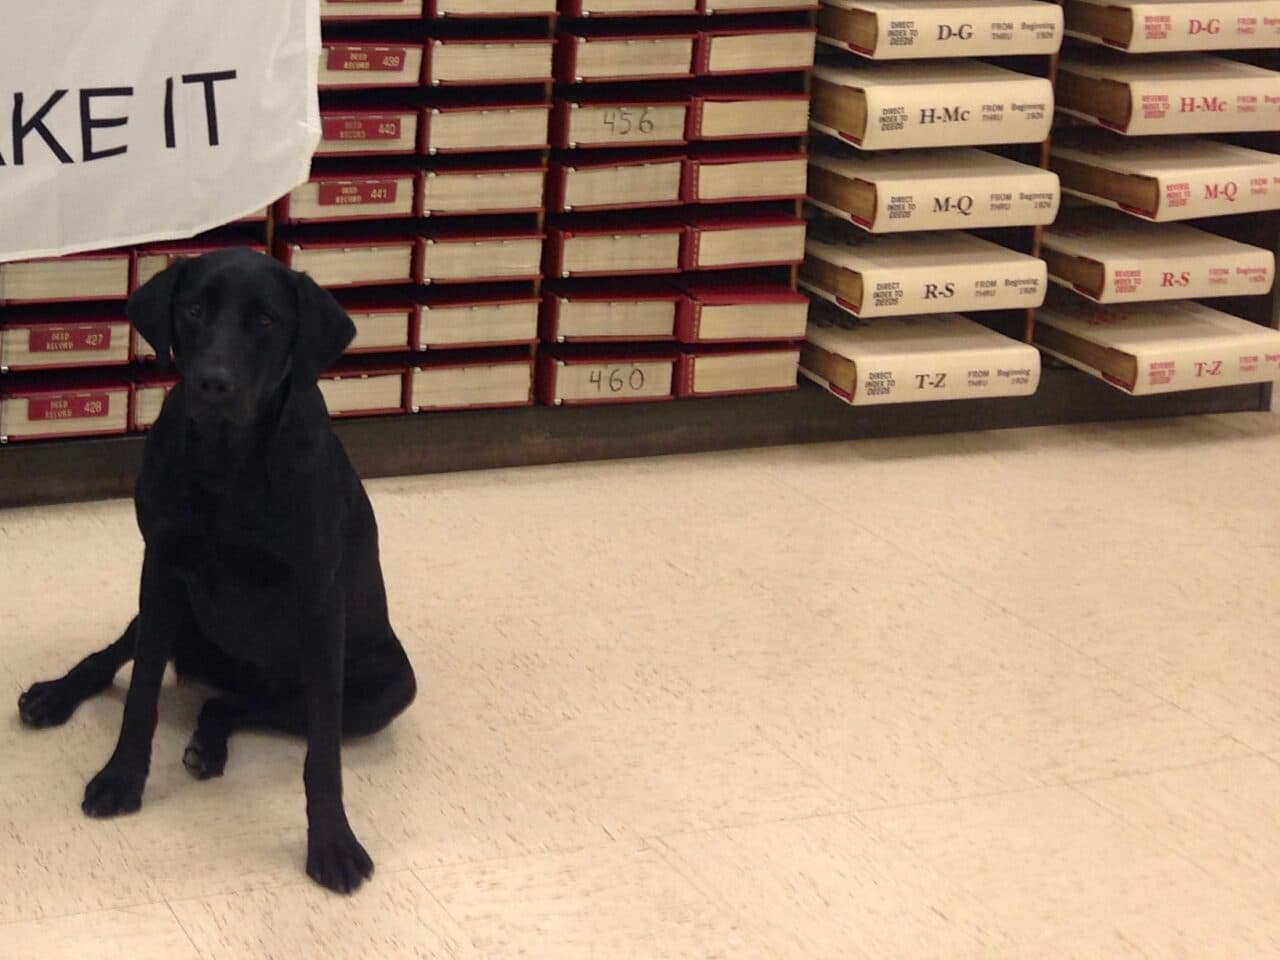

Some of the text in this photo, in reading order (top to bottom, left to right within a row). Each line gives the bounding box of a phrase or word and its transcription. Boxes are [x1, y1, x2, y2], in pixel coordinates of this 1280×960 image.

[937, 24, 974, 40] D-G
[1021, 22, 1056, 31] Beginning
[1188, 19, 1221, 35] D-G
[164, 70, 236, 148] IT
[982, 103, 1045, 112] FROM Beginning
[1179, 96, 1227, 113] H-Mc
[603, 107, 654, 136] 456
[920, 106, 970, 124] H-Mc
[378, 123, 396, 135] 440
[371, 188, 388, 199] 441
[990, 192, 1054, 201] FROM Beginning
[1204, 181, 1238, 202] M-Q
[933, 195, 973, 216] M-Q
[975, 279, 1039, 288] FROM Beginning
[1160, 271, 1191, 288] R-S
[924, 282, 955, 300] R-S
[46, 341, 74, 351] RECORD
[85, 333, 103, 346] 427
[968, 369, 1031, 378] FROM Beginning
[1194, 360, 1223, 377] T-Z
[590, 368, 644, 392] 460
[915, 372, 947, 390] T-Z
[45, 409, 73, 419] RECORD
[84, 401, 102, 413] 428
